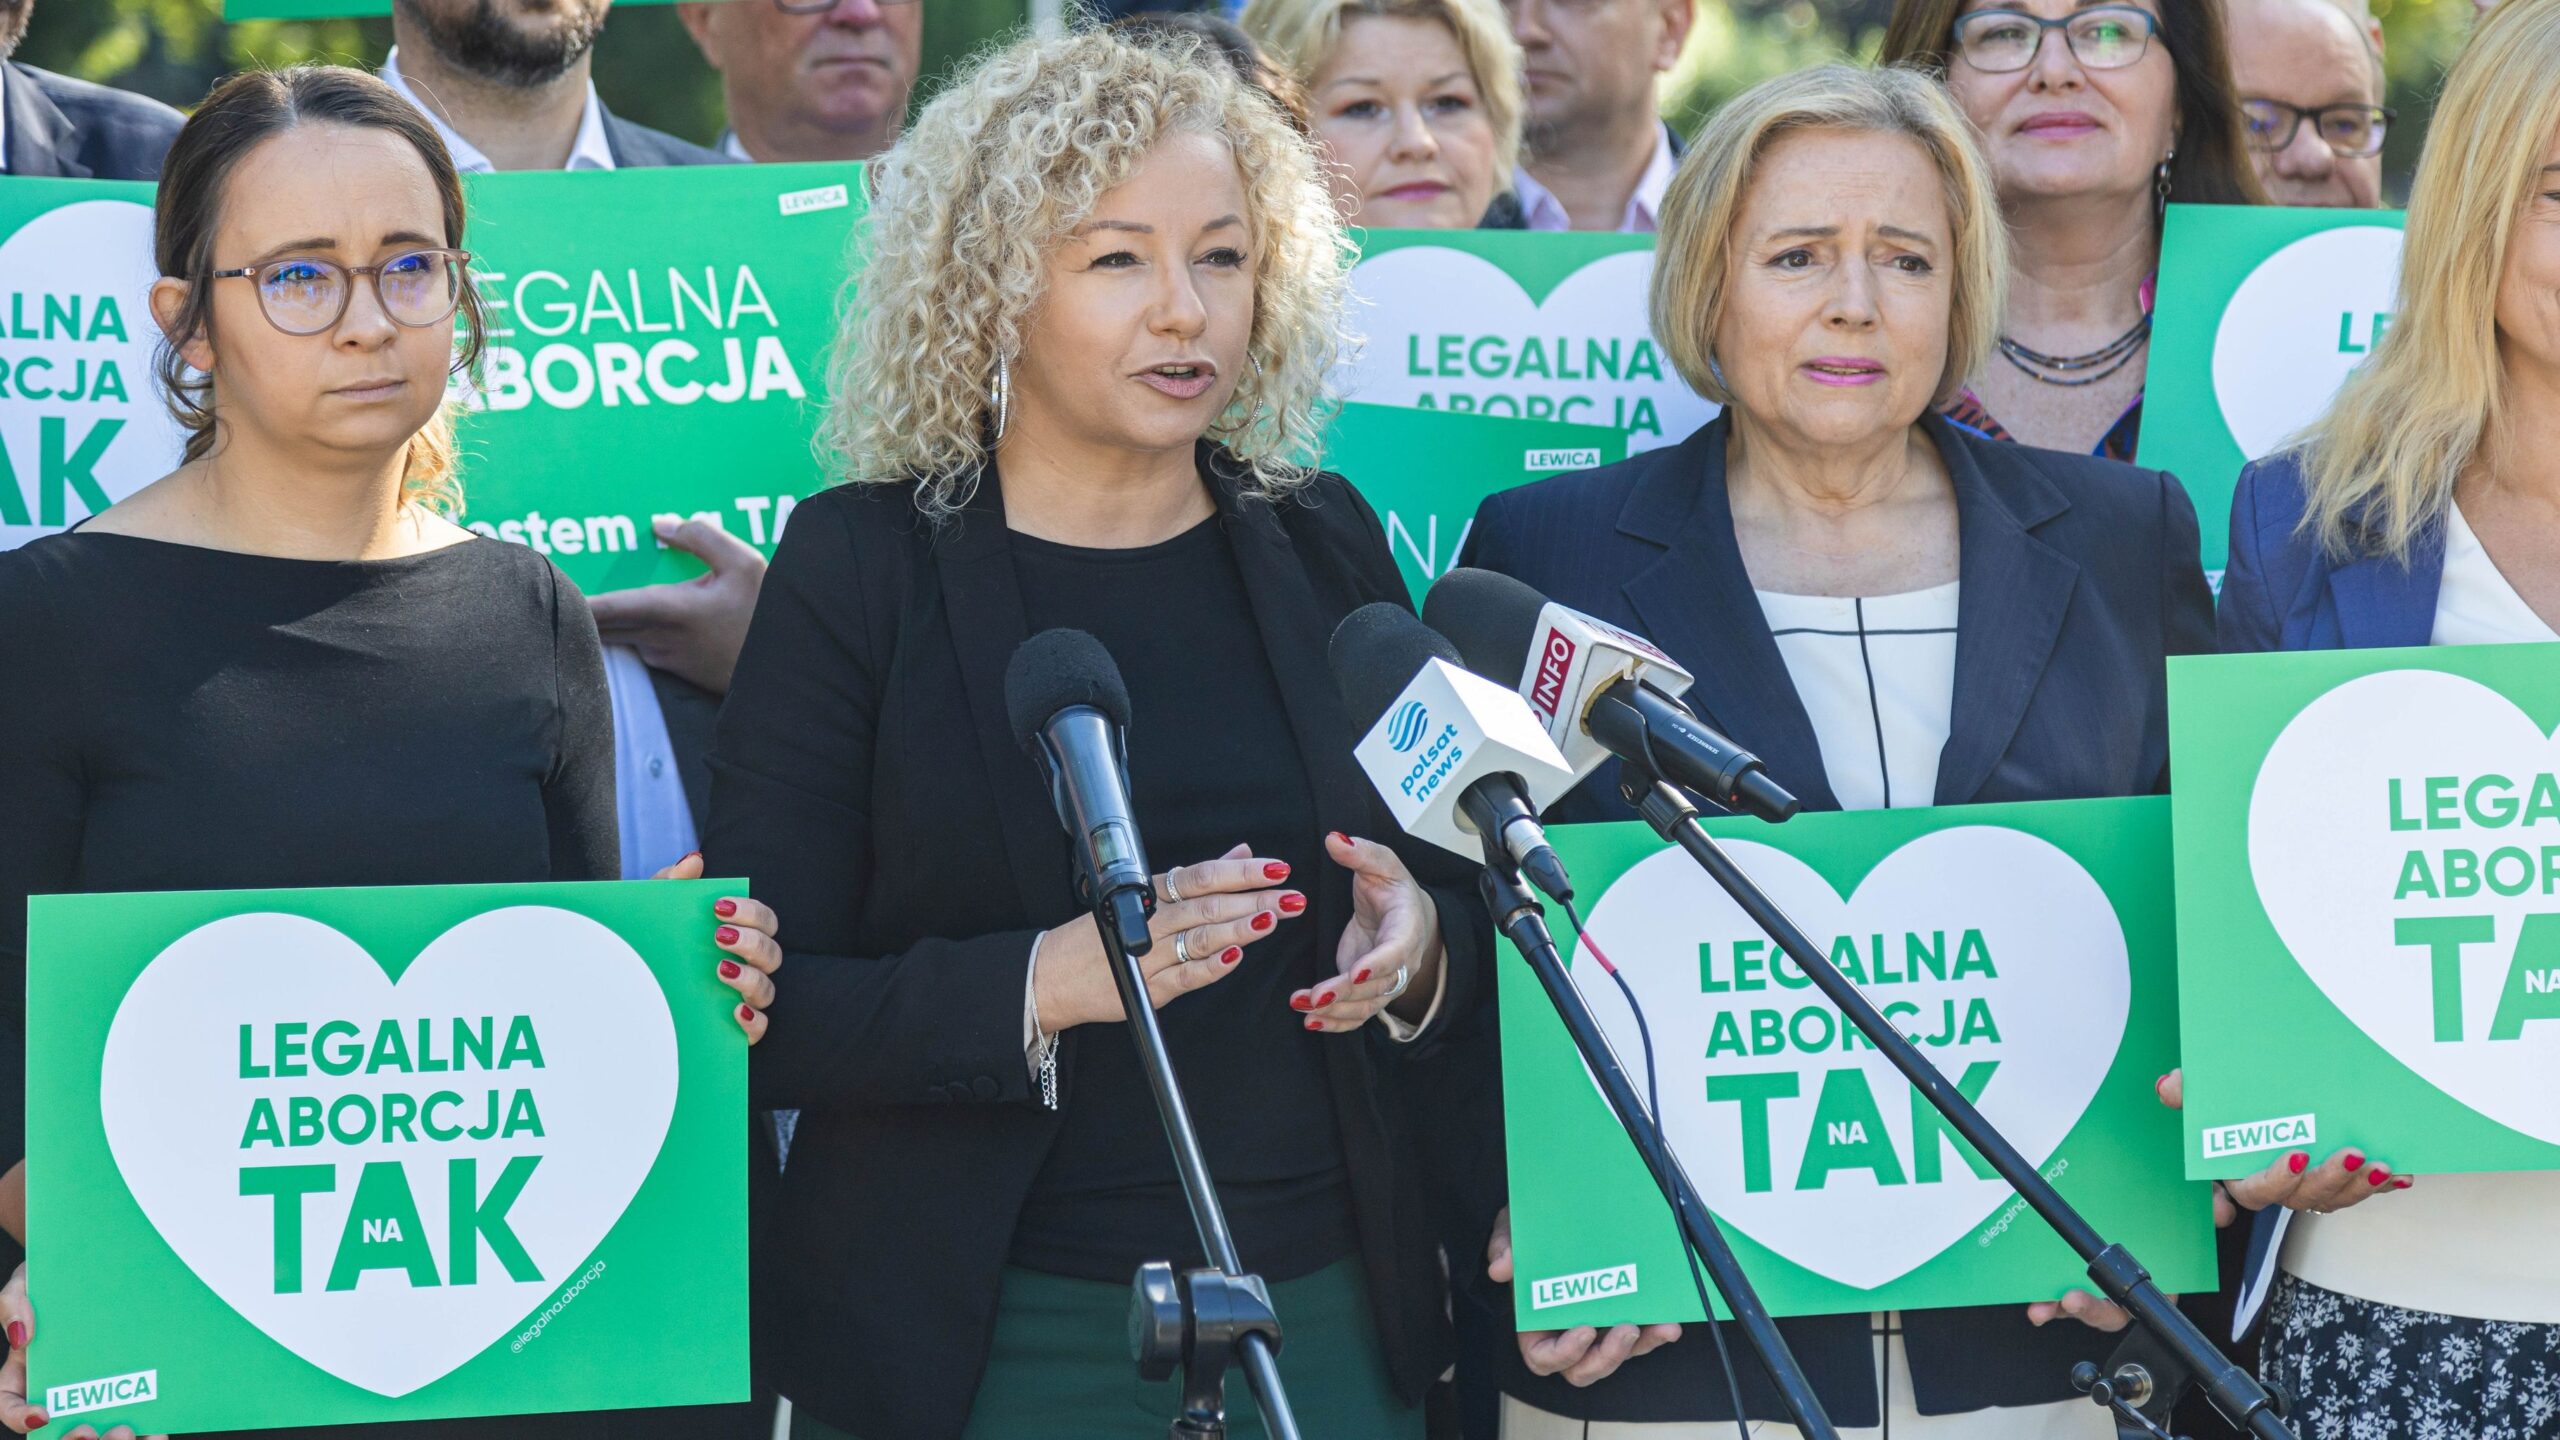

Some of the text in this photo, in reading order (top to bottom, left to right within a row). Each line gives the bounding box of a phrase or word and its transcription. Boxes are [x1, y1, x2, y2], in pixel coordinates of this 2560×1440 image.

[0, 292, 129, 342] LNA
[453, 265, 779, 336] EGALNA
[1408, 334, 1664, 381] LEGALNA
[1530, 452, 1597, 467] LEWICA
[1536, 636, 1570, 709] INFO
[1401, 723, 1458, 797] polsat
[1416, 746, 1463, 803] news
[2388, 773, 2560, 831] LEGA
[239, 1015, 546, 1079] LEGALNA
[239, 1088, 546, 1149] ABORCJA
[1827, 1121, 1868, 1145] NA
[2210, 1119, 2310, 1152] LEWICA
[239, 1155, 546, 1294] TAK
[362, 1217, 404, 1243] NA
[511, 1260, 606, 1353] @legalna.aborcja
[1539, 1270, 1631, 1303] LEWICA
[54, 1376, 151, 1412] LEWICA
